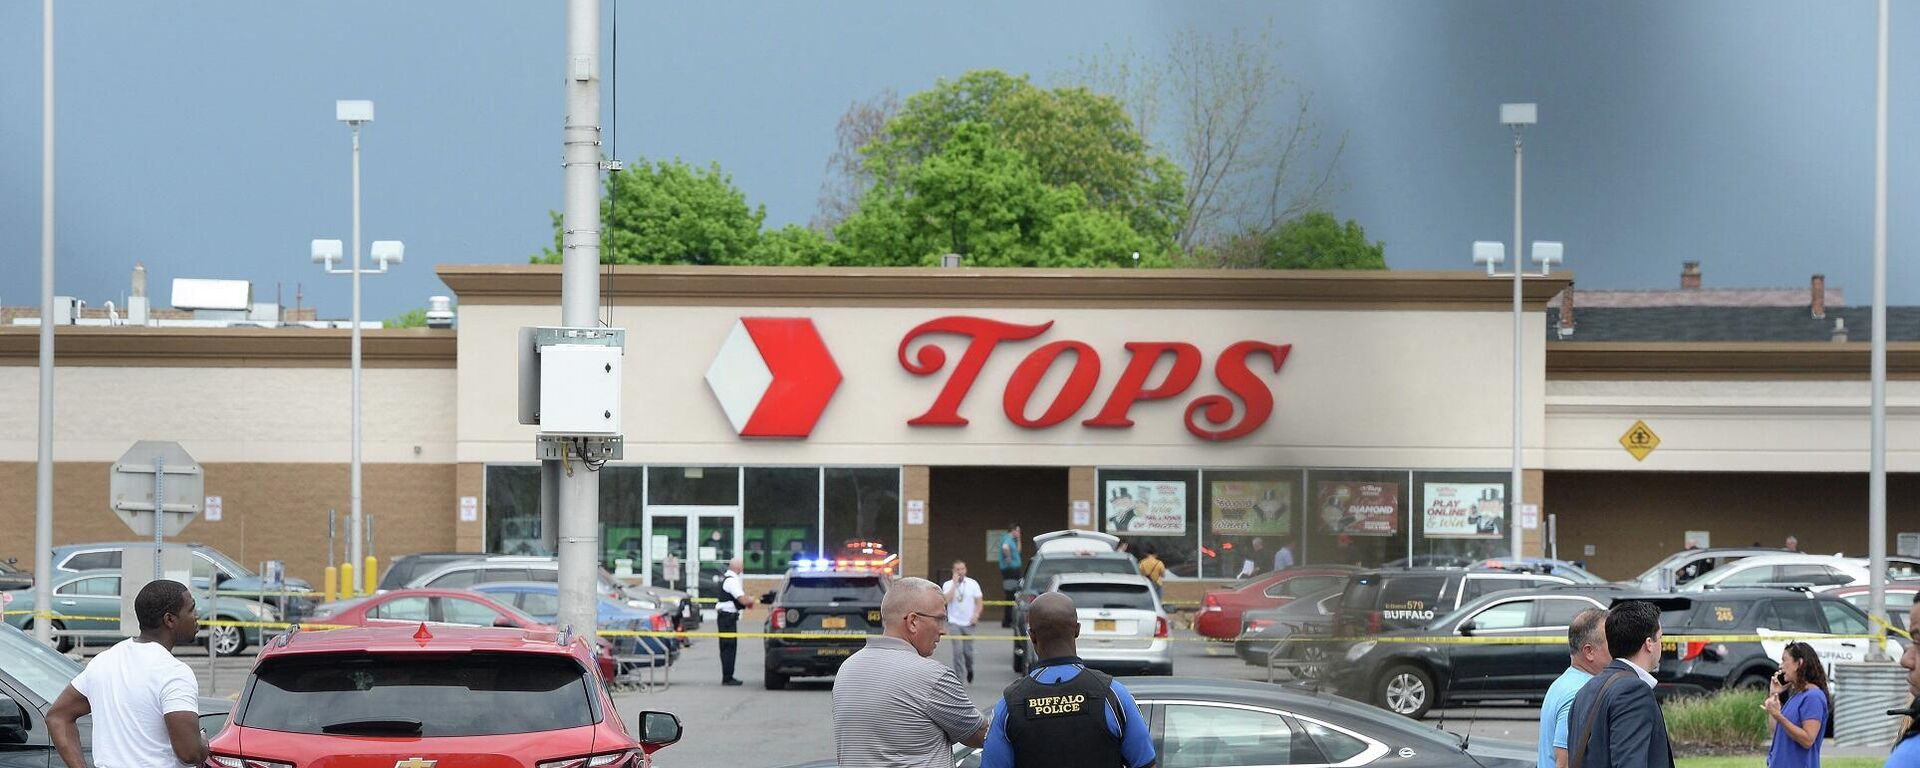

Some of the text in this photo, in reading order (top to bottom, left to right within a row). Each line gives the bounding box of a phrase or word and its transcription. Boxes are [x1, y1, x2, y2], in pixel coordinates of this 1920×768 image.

[1433, 499, 1460, 508] PLAY
[1349, 504, 1394, 514] DIAMOND
[1427, 508, 1467, 516] ONLINE
[1407, 601, 1424, 610] 579
[1383, 610, 1434, 620] BUFFALO
[1029, 694, 1085, 708] BUFFALO
[1035, 703, 1080, 715] POLICE
